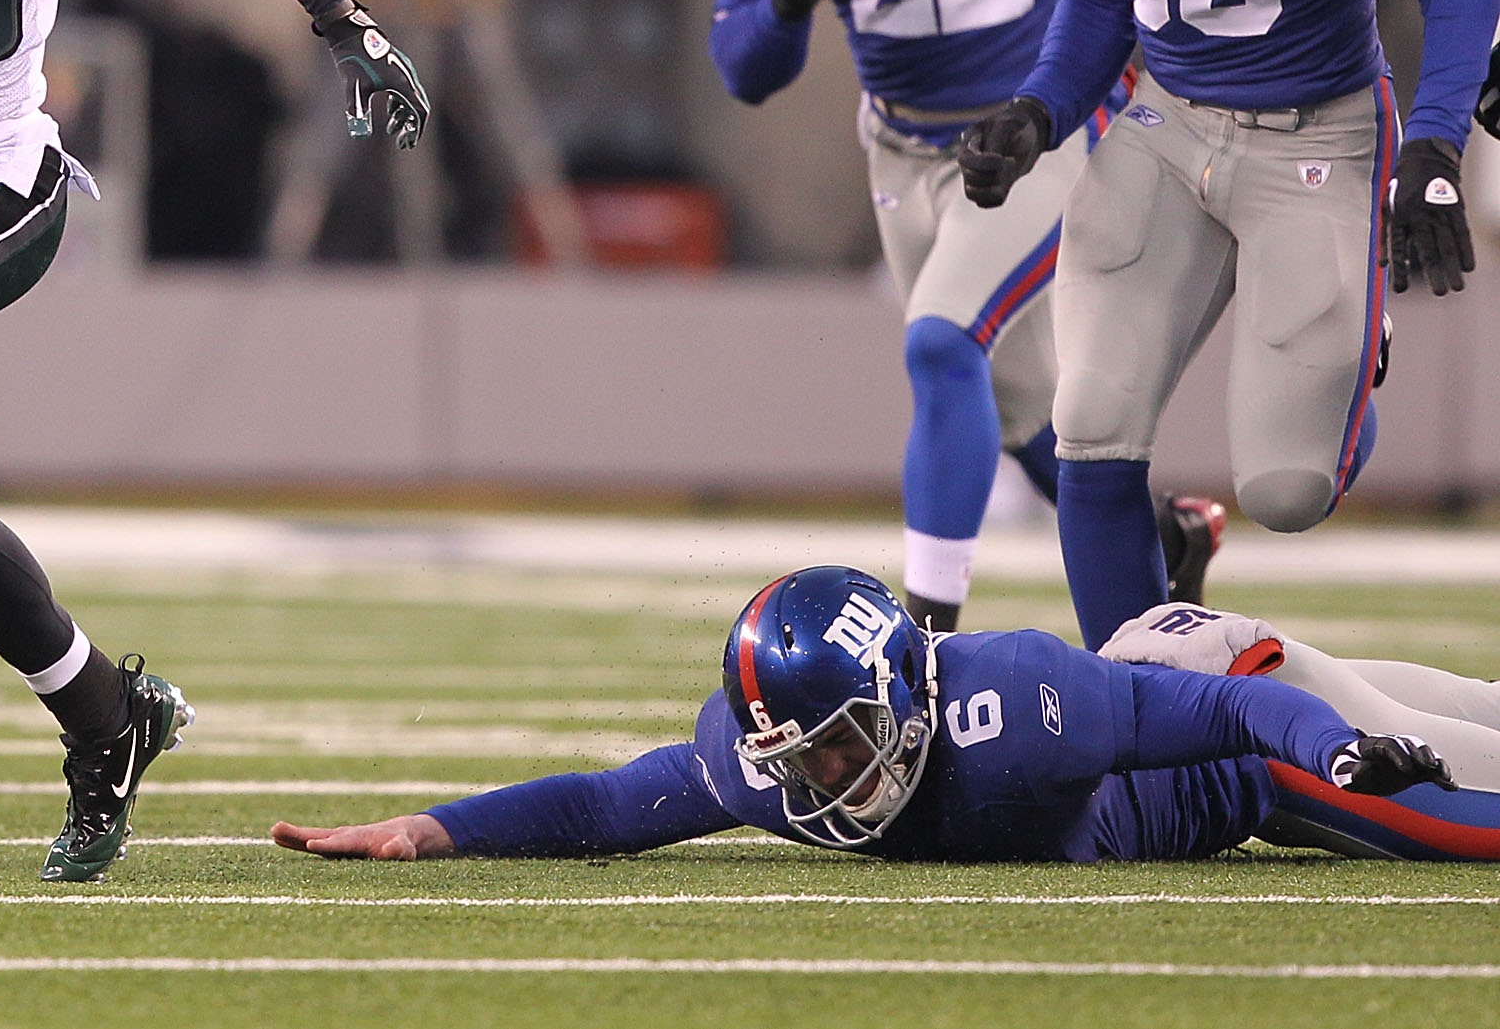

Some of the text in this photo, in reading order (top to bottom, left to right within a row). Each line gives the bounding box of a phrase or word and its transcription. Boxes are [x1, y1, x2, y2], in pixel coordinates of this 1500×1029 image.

[750, 700, 772, 731] 6
[945, 689, 1004, 749] 6
[878, 716, 888, 750] iddell
